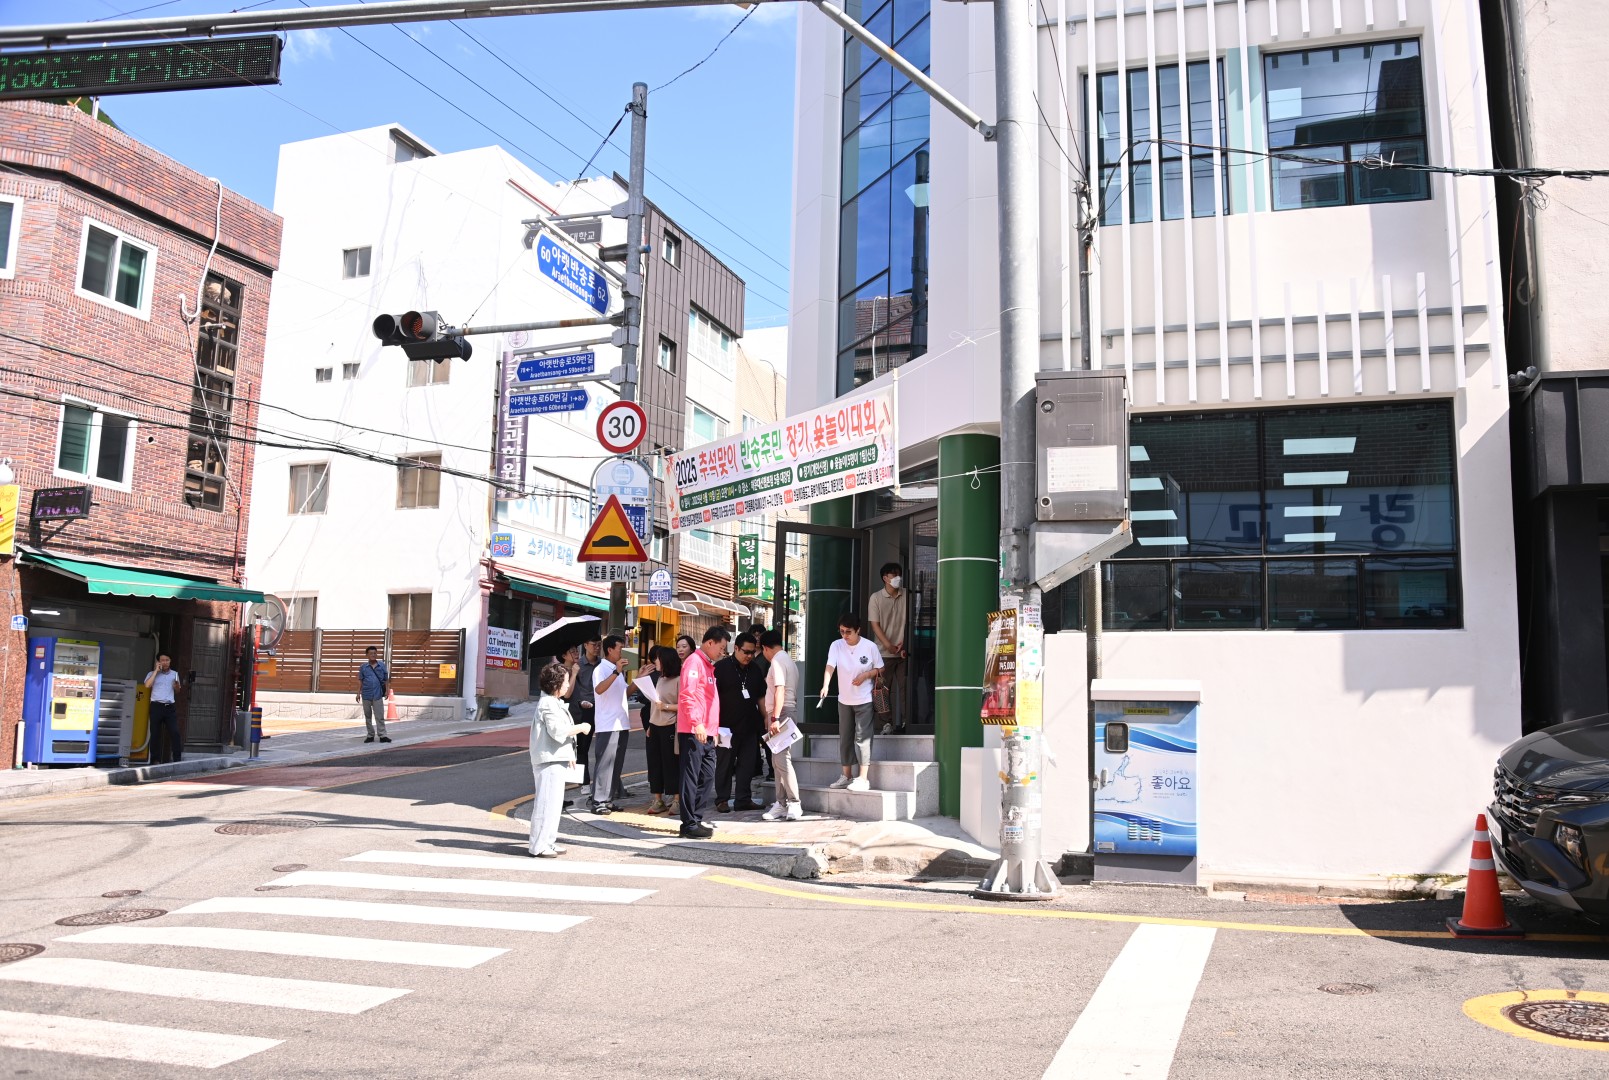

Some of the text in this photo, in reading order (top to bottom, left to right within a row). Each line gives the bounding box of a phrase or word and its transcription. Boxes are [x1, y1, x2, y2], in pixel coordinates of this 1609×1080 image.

[540, 245, 551, 263] 60
[552, 246, 596, 290] 아랫반송로
[597, 286, 606, 302] 62
[538, 353, 594, 369] 아랫반송로59번길
[510, 392, 568, 406] 아랫반송로60번길
[608, 415, 635, 439] 30
[675, 456, 698, 486] 2025
[698, 444, 739, 481] 추석맞이
[739, 428, 784, 470] 반송주민
[493, 544, 509, 555] PC
[588, 564, 637, 581] 속도를 줄이시오
[1150, 775, 1192, 790] 좋아요
